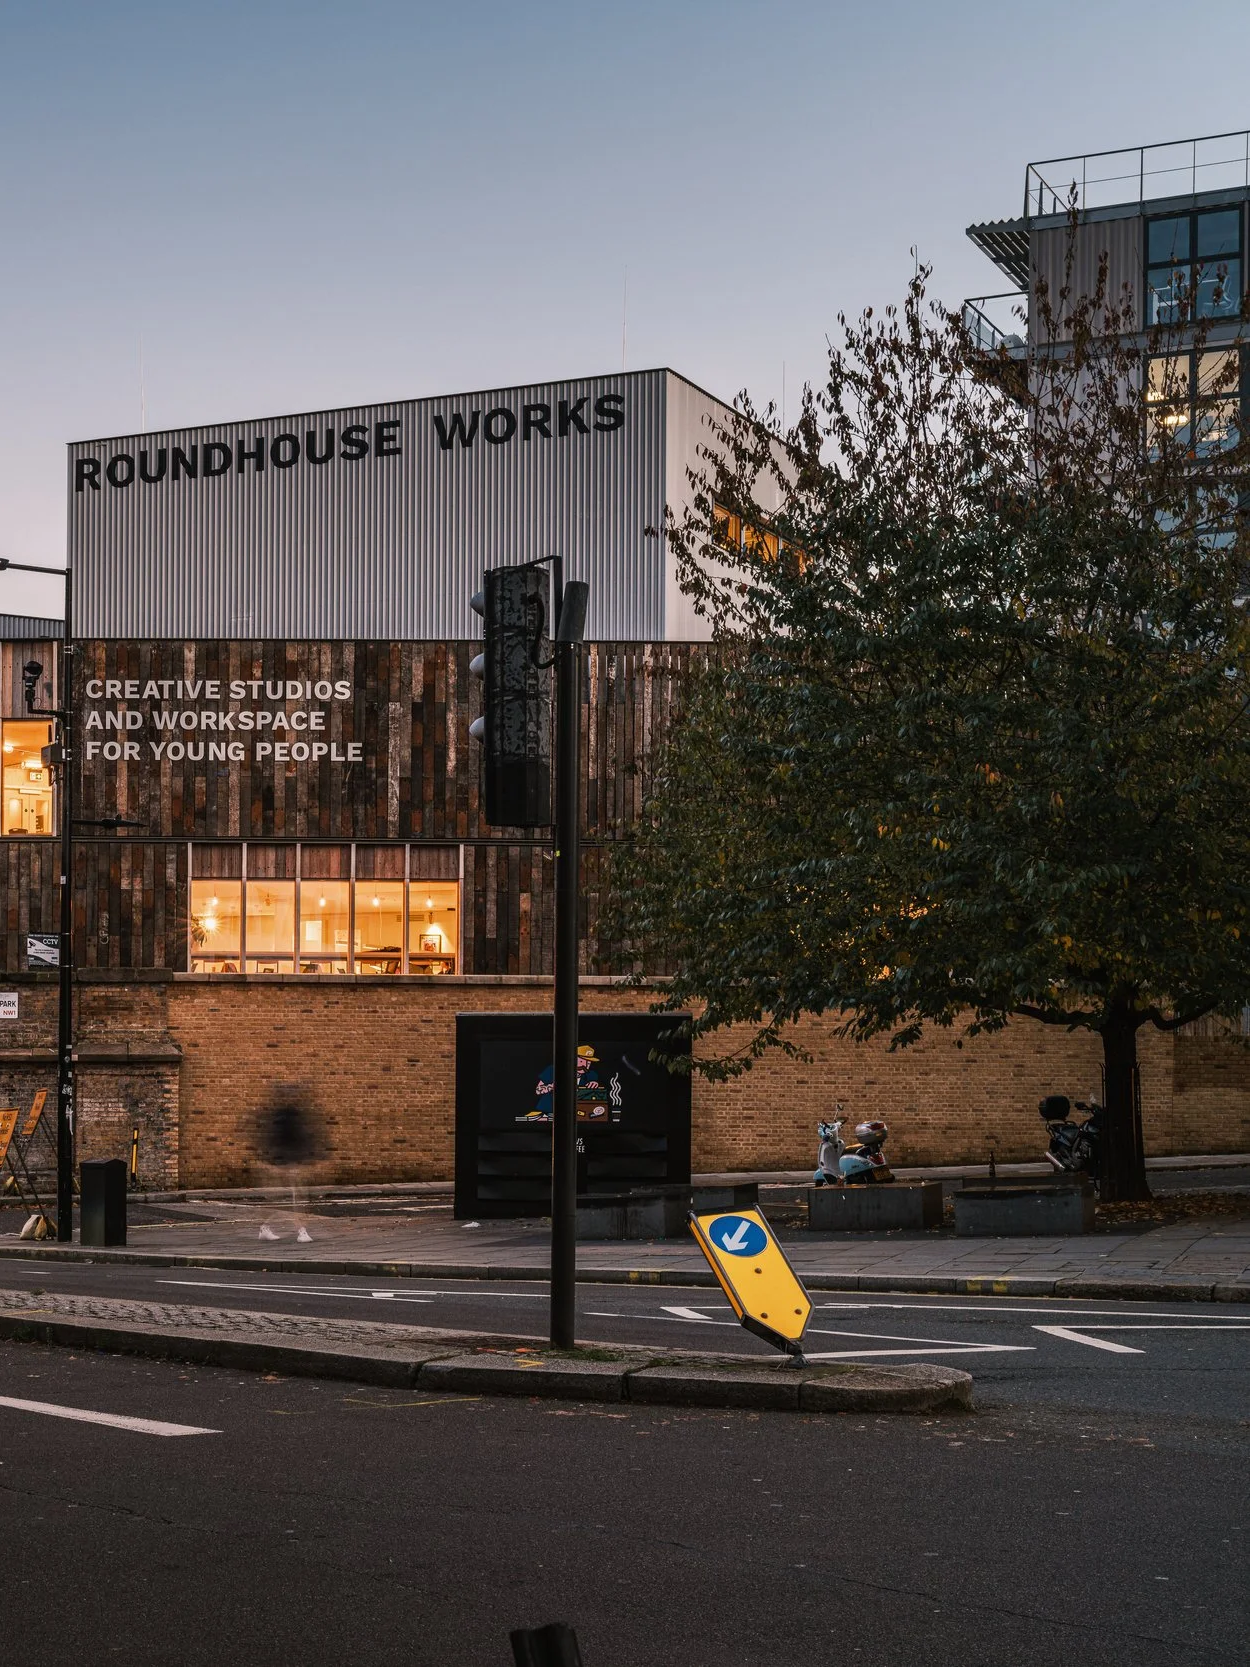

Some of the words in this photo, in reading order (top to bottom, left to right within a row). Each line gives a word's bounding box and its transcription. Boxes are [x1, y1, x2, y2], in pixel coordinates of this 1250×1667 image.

[75, 420, 402, 492] ROUNDHOUSE
[433, 394, 626, 451] WORKS
[85, 679, 221, 699] CREATIVE
[229, 679, 351, 700] STUDIOS
[85, 710, 143, 730] AND
[152, 710, 326, 731] WORKSPACE
[86, 741, 141, 761] FOR
[149, 741, 246, 761] YOUNG
[256, 741, 363, 762] PEOPLE
